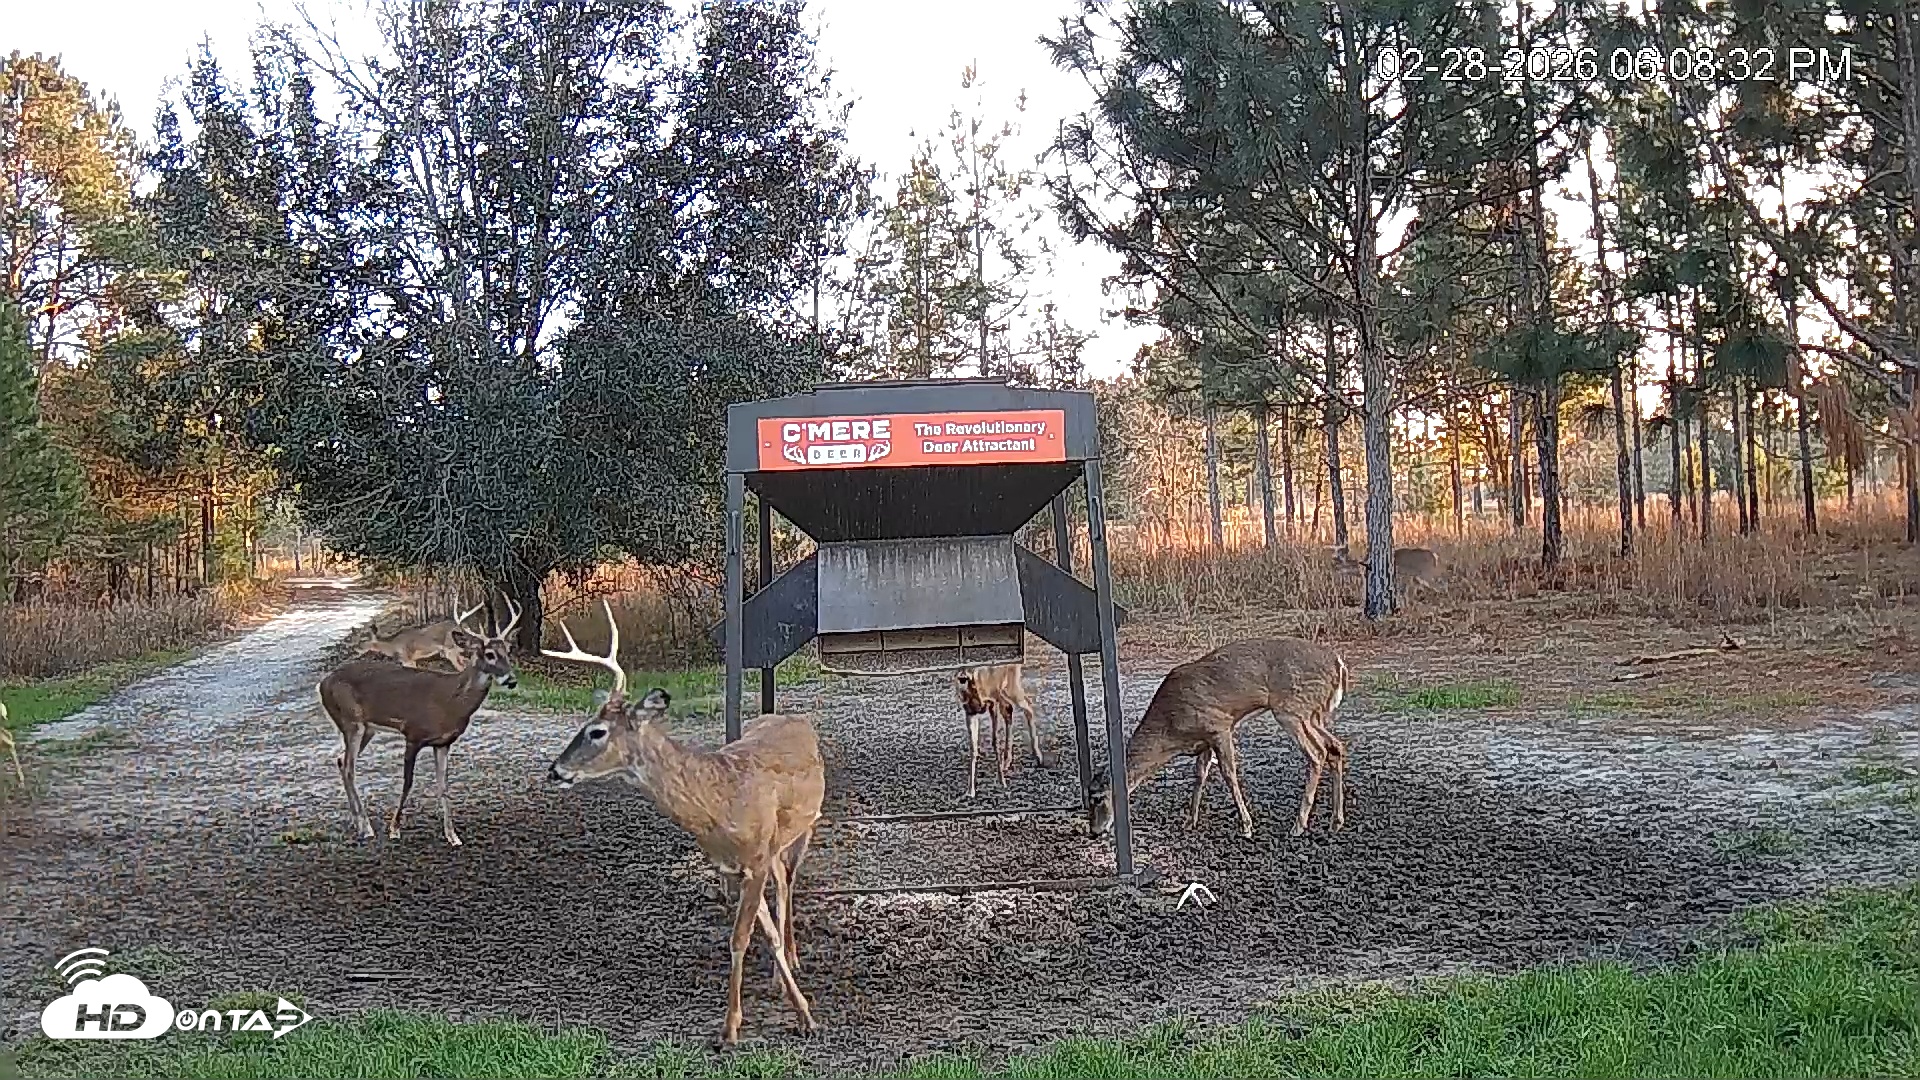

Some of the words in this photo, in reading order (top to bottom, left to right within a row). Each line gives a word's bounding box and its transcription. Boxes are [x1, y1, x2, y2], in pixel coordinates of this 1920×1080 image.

[782, 420, 891, 443] C'MERE
[914, 422, 942, 437] The
[945, 420, 1046, 436] Revolutionary
[923, 441, 958, 453] Deer
[961, 438, 1036, 453] Attractant
[813, 449, 861, 460] DEER
